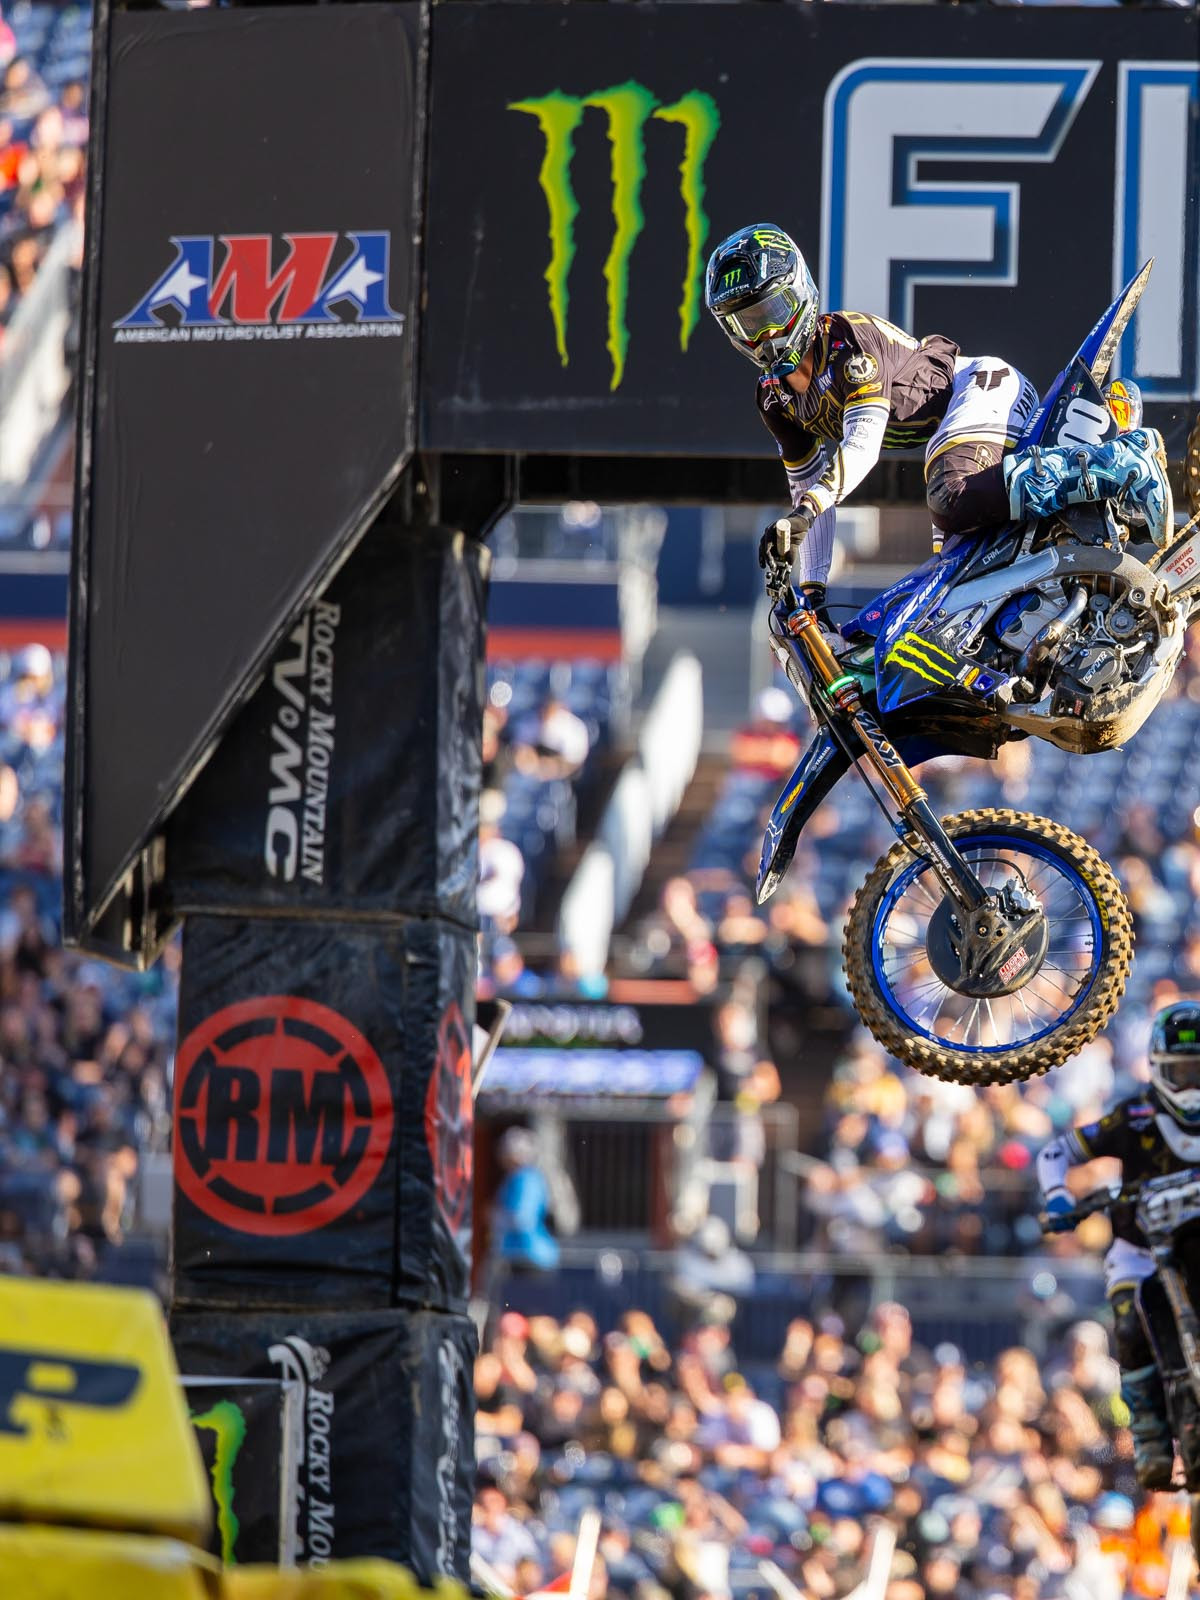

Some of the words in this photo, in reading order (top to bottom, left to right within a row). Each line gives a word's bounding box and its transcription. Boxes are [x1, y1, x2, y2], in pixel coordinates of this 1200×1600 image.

[112, 230, 405, 329] AMA
[114, 327, 190, 343] AMERICAN
[192, 325, 302, 342] MOTORCYCLIST
[305, 323, 403, 340] ASSOCIATION
[1022, 407, 1045, 437] YAMAHA
[1164, 546, 1194, 573] BRAKING
[310, 600, 340, 705] ROCKY
[815, 746, 831, 766] YAMAHA
[301, 704, 335, 886] MOUNTAIN
[913, 830, 962, 897] DUNLOP
[931, 841, 952, 869] BRAKING
[1081, 868, 1111, 932] DUNLOP
[202, 1065, 346, 1166] RM
[307, 1386, 334, 1494] ROCKY
